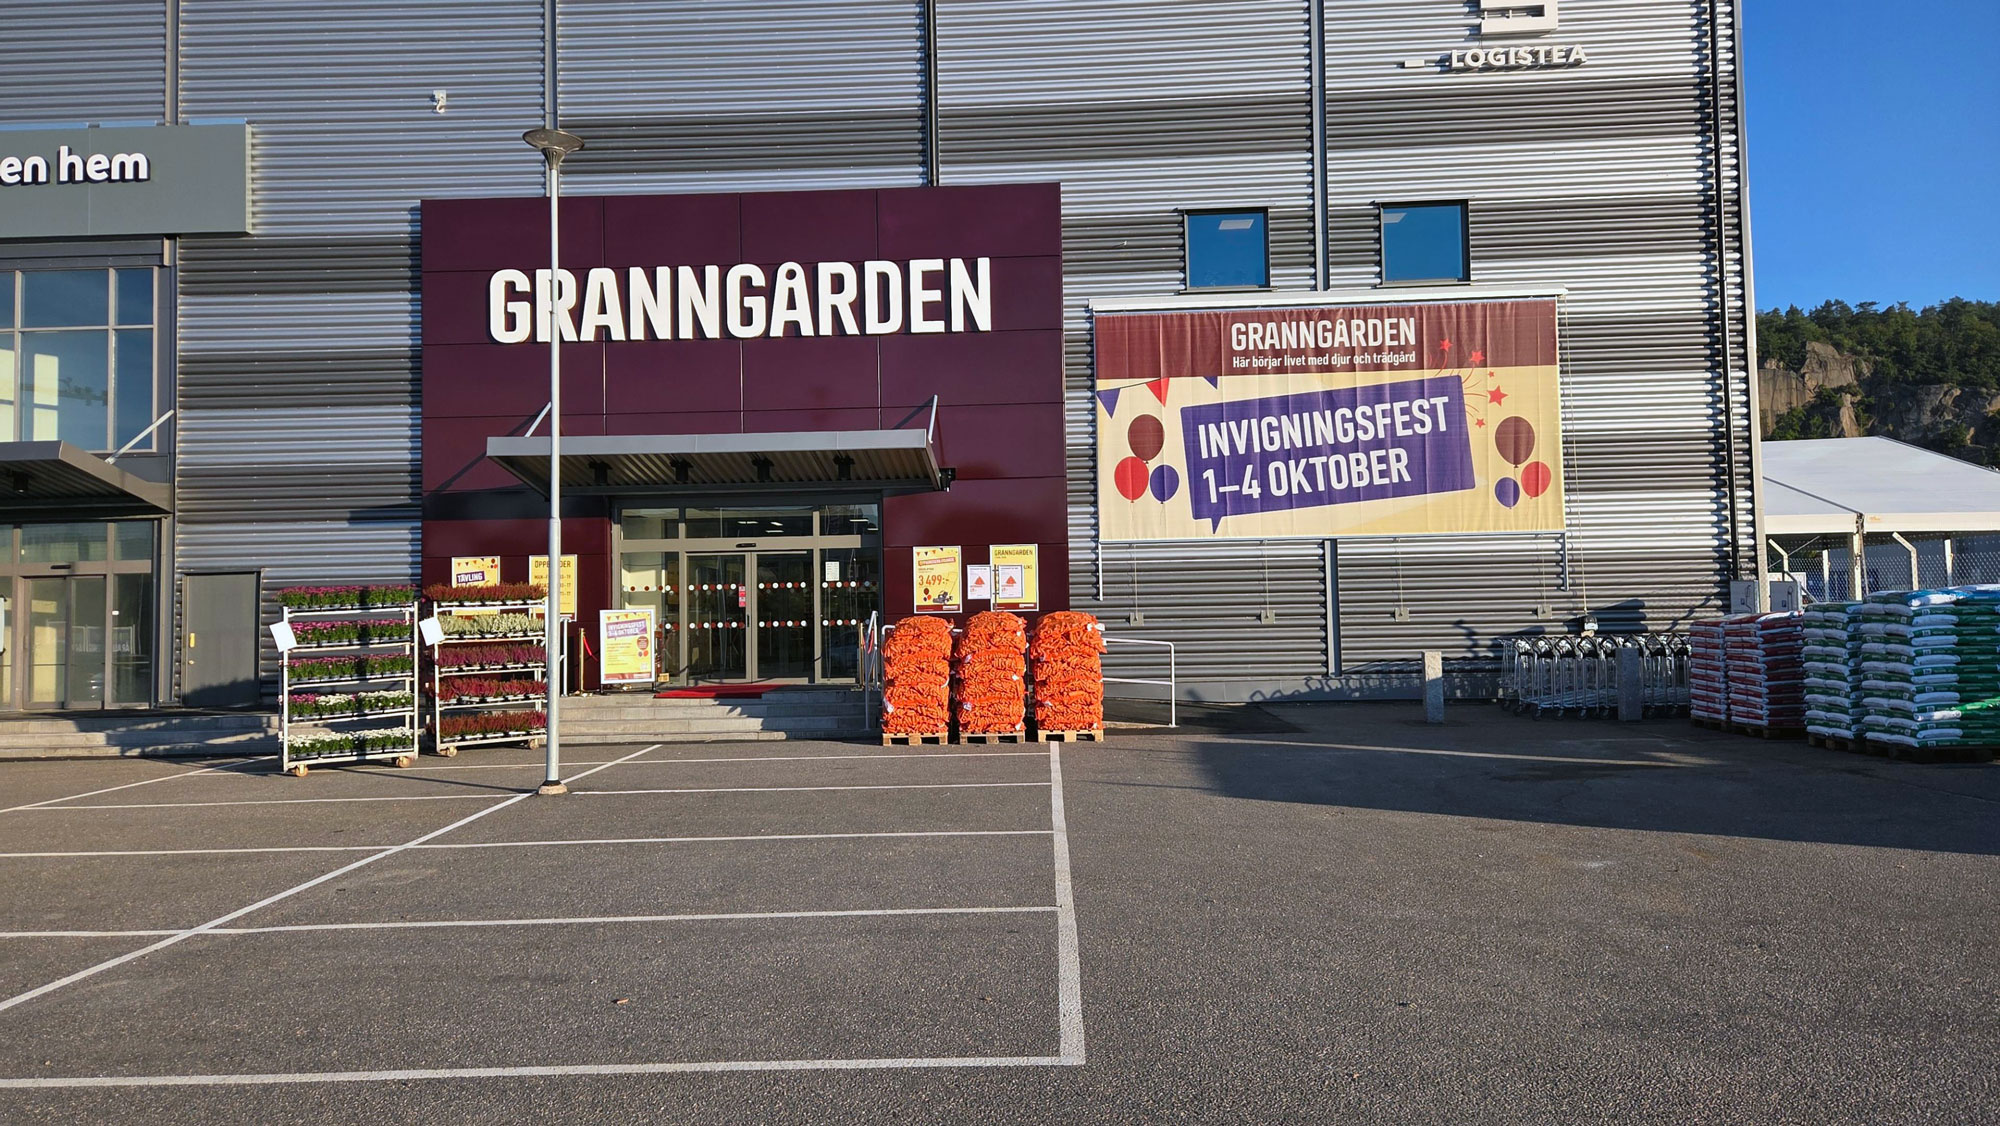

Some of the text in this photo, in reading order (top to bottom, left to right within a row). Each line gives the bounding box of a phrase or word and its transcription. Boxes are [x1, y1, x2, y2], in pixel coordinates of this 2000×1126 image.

[1451, 44, 1588, 68] LOGISTEA
[59, 146, 148, 181] hem
[489, 257, 992, 344] GRANNGÅRDEN
[1231, 317, 1416, 351] GRANNGÅRDEN
[1232, 351, 1416, 370] Här börjar livet med djur och trädgård
[1198, 396, 1450, 460] INVIGNINGSFEST
[1268, 447, 1412, 498] OKTOBER
